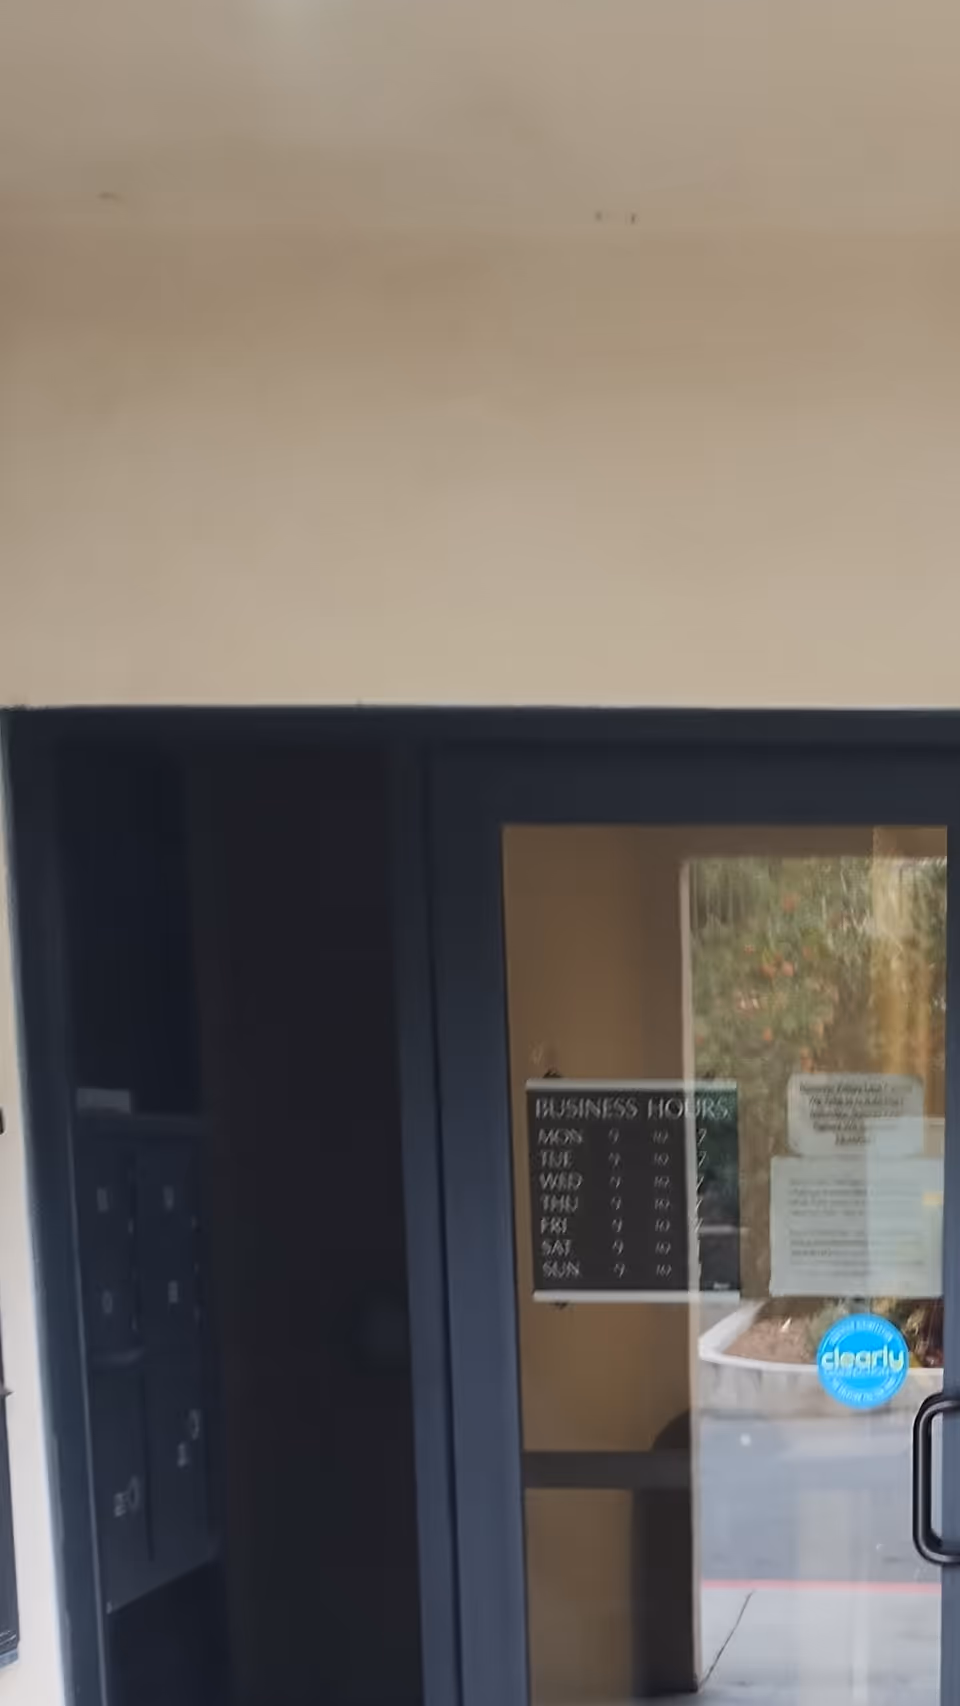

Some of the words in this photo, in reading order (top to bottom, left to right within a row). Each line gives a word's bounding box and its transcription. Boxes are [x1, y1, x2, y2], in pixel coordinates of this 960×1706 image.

[535, 1097, 639, 1119] BUSINESS
[648, 1097, 729, 1120] HOURS
[538, 1128, 584, 1146] MON
[540, 1151, 572, 1168] TUE
[539, 1172, 584, 1190] WED
[541, 1195, 579, 1212] THU
[540, 1217, 568, 1234] FRI
[541, 1239, 572, 1256] SAT
[542, 1261, 581, 1279] SUN
[821, 1344, 905, 1373] clearly
